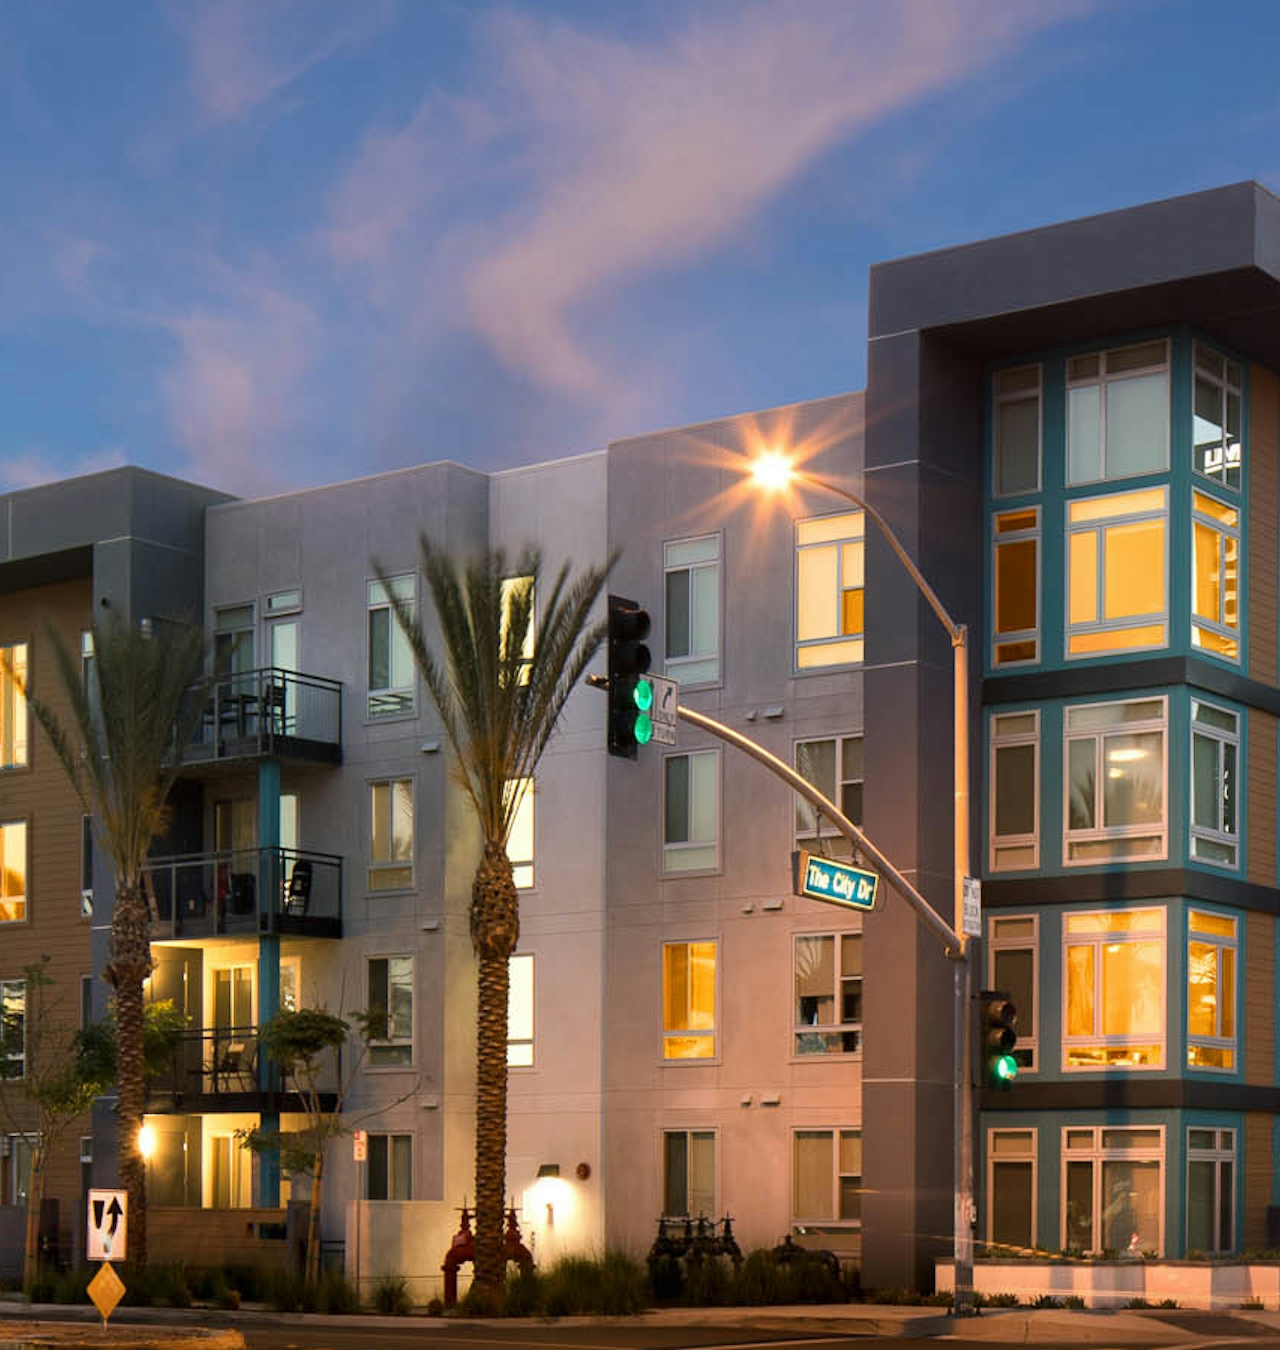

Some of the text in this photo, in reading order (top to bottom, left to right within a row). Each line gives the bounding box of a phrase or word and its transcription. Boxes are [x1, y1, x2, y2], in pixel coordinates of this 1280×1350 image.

[808, 865, 873, 900] The City Dr
